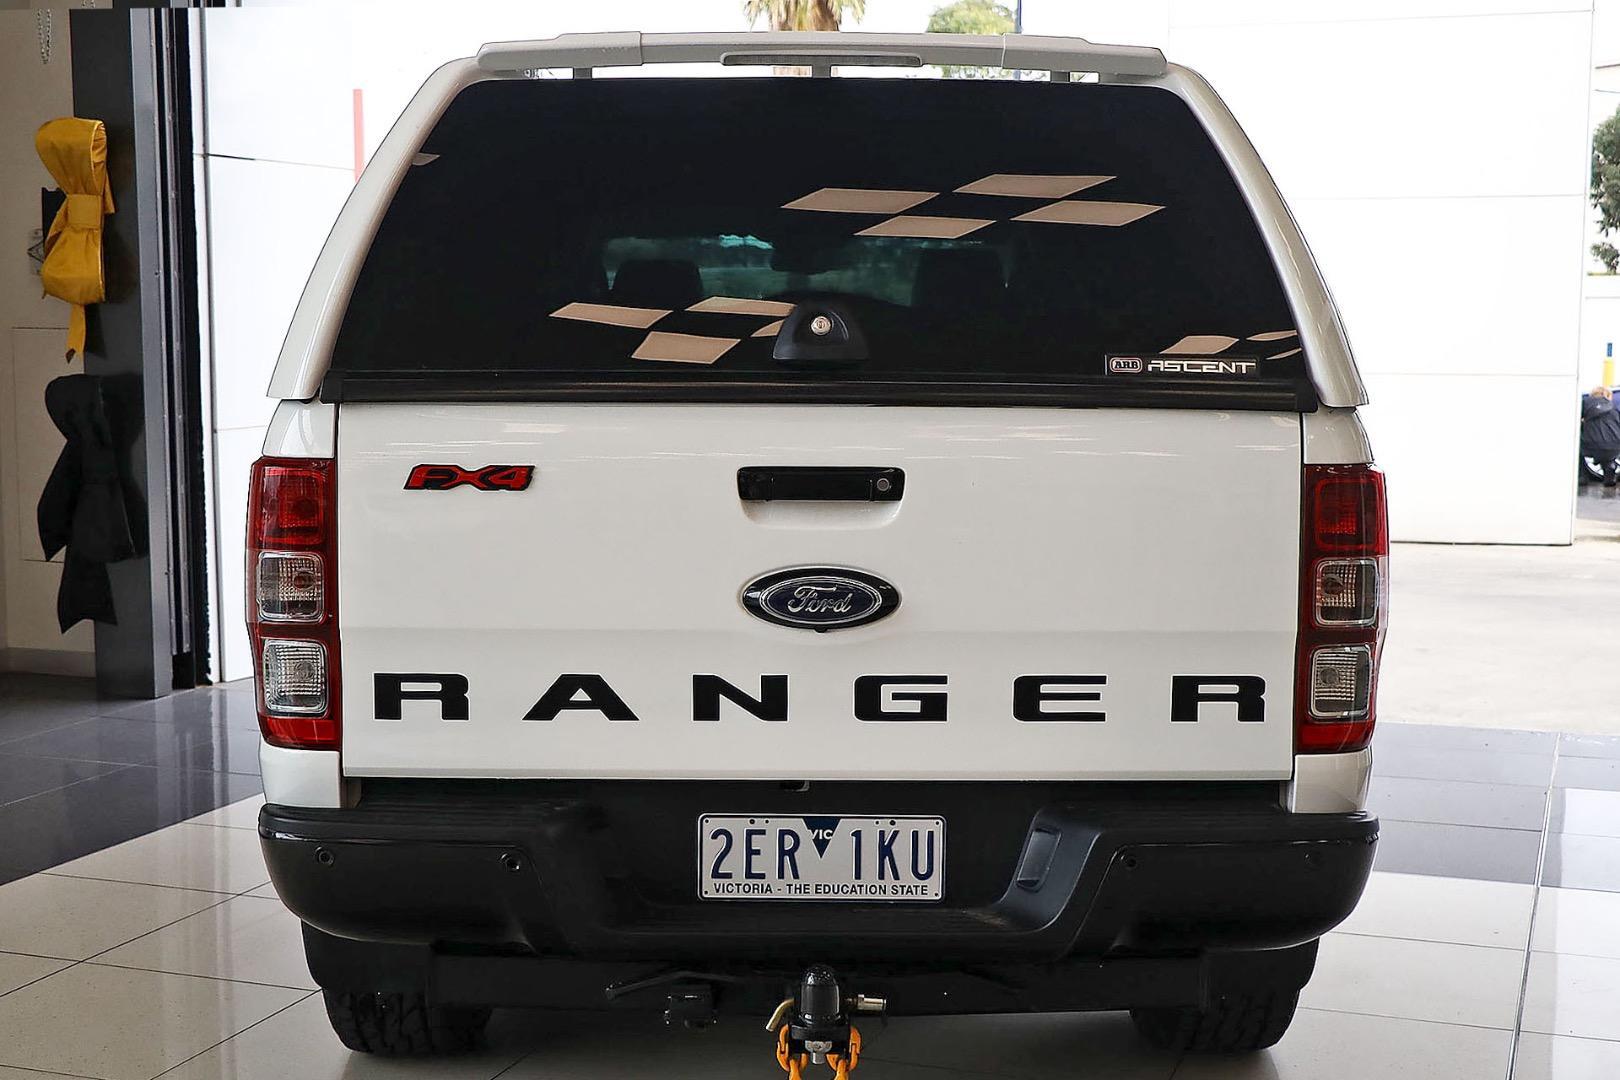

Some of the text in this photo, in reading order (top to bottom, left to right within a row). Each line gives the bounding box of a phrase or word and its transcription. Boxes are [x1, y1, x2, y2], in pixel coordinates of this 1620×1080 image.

[1147, 360, 1256, 373] ASCENT
[404, 464, 534, 491] FX4
[787, 585, 853, 612] Ford
[374, 673, 1264, 721] RANGER
[809, 829, 833, 840] VIC
[710, 828, 934, 881] 2ER 1KU
[713, 883, 773, 894] VICTORIA
[786, 884, 810, 895] THE
[814, 884, 886, 895] EDUCATION
[890, 884, 928, 895] STATE
